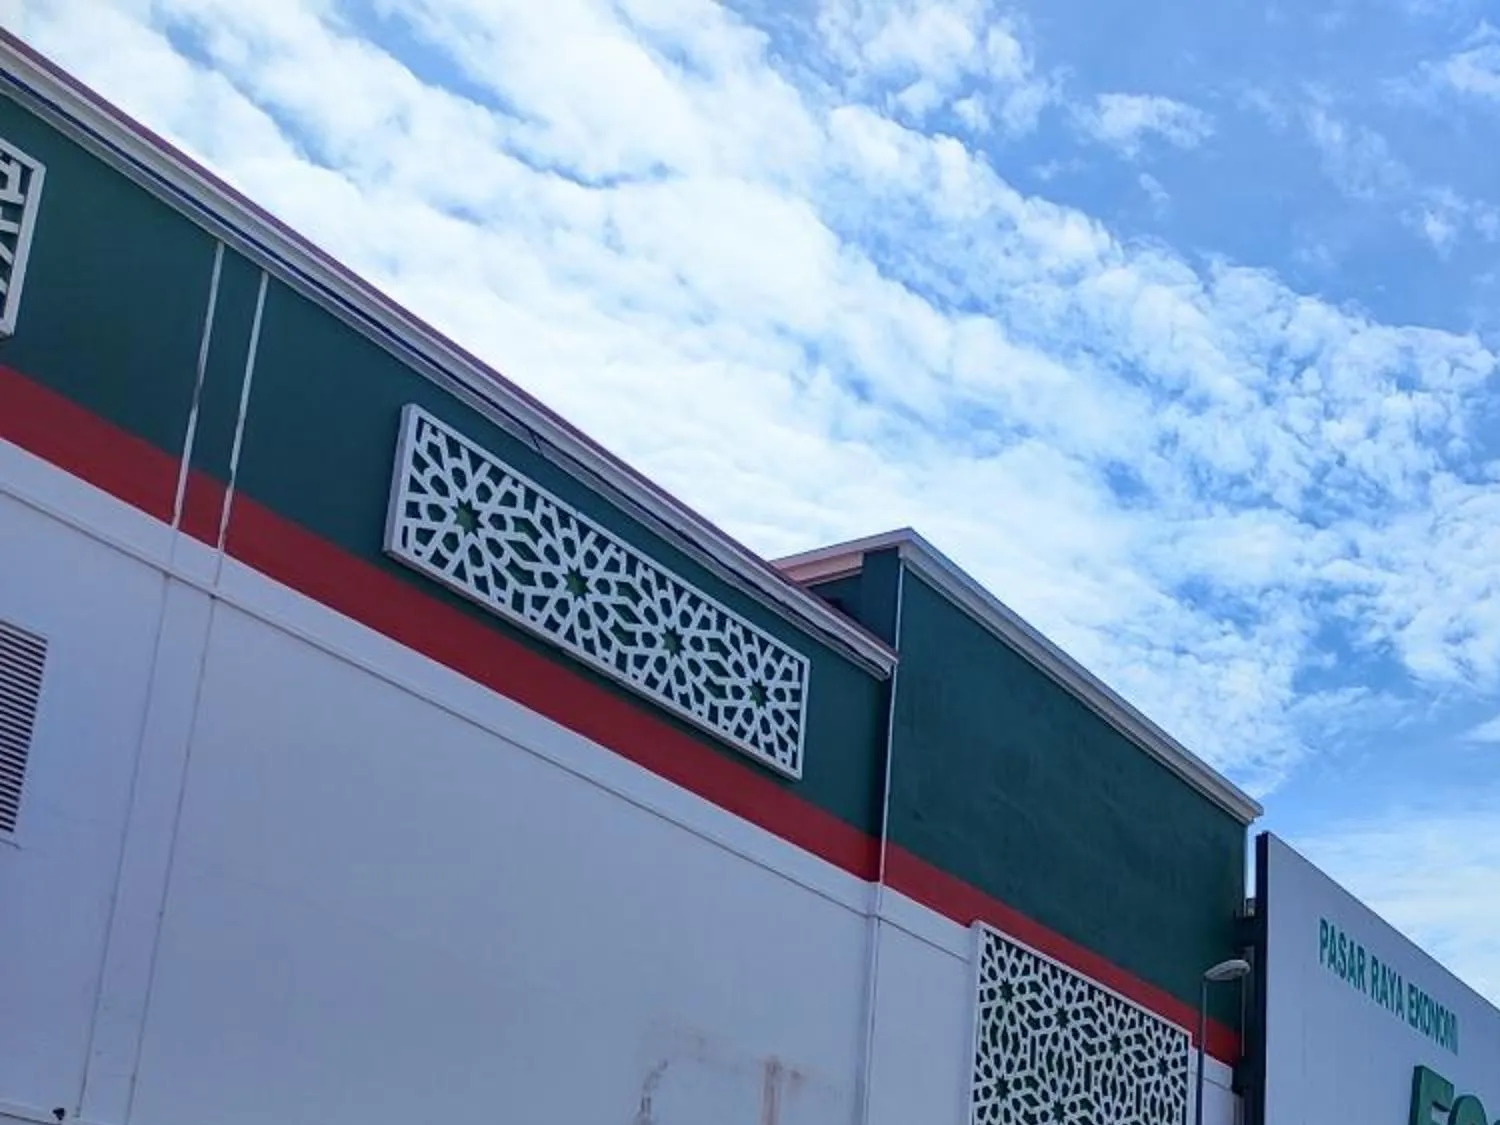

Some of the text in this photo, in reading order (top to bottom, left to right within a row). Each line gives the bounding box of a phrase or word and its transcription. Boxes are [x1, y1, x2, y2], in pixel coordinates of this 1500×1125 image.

[1319, 917, 1458, 1057] PASAR RAYA EKONOMI
